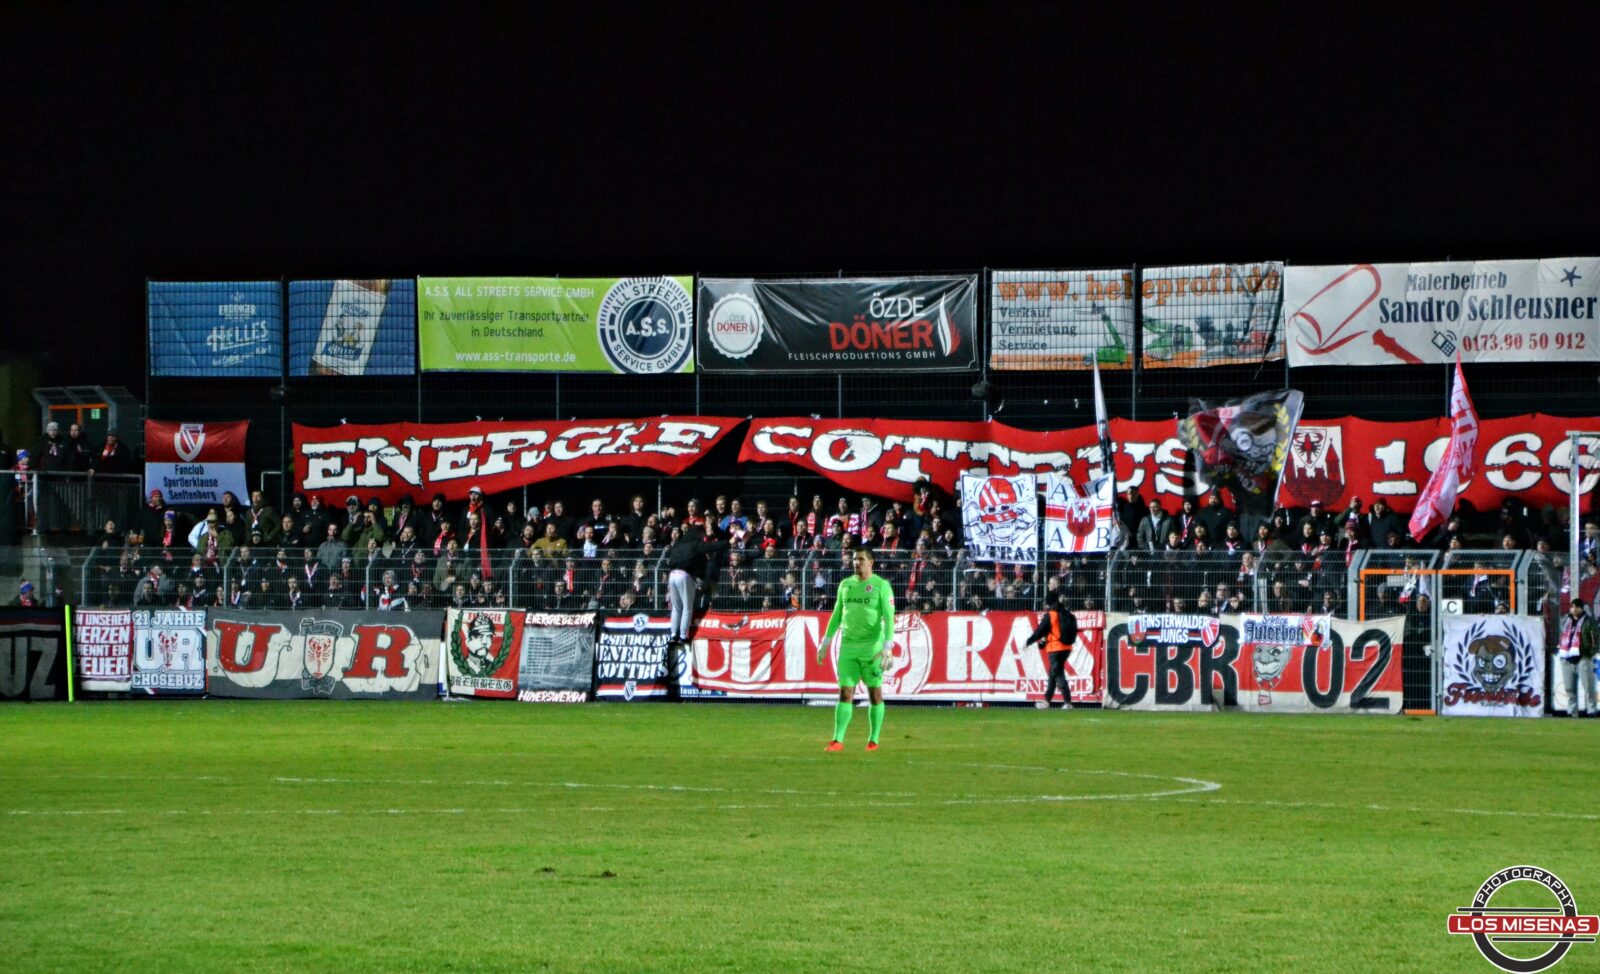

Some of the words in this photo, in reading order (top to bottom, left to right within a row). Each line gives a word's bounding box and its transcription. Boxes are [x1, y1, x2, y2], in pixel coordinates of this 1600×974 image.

[1407, 271, 1508, 292] Malerbetrieb
[425, 286, 450, 297] A.S.S.
[455, 286, 472, 297] ALL
[477, 286, 520, 297] STREETS
[524, 286, 562, 297] SERVICE
[566, 287, 594, 298] GMBH
[612, 293, 631, 314] ALL
[632, 284, 682, 311] STREETS
[218, 304, 256, 316] ERDINGER
[870, 292, 926, 318] ÖZDE
[999, 306, 1052, 318] Verkauf
[1380, 298, 1460, 324] Sandro
[1468, 292, 1598, 322] Schleusner
[424, 310, 434, 321] Ihr
[439, 310, 504, 323] zuverlässiger
[508, 310, 590, 323] Transportpartner
[471, 326, 480, 337] in
[484, 326, 545, 338] Deutschland.
[626, 316, 670, 337] A.S.S.
[829, 314, 934, 350] DÖNER
[999, 323, 1078, 336] Vermietung
[206, 320, 269, 352] HELLES
[1462, 333, 1522, 352] 0173.90
[1529, 334, 1549, 350] 50
[1555, 332, 1586, 350] 912
[999, 340, 1047, 351] Service
[455, 350, 576, 364] www.ass-transporte.de
[614, 344, 653, 372] SERVICE
[656, 343, 683, 370] GMBH
[788, 352, 901, 361] FLEISCHPRODUKTIONS
[905, 350, 936, 360] GMBH
[302, 421, 721, 490] ENERGIE
[174, 464, 204, 476] Fanclub
[168, 490, 217, 502] Senftenberg
[1446, 600, 1458, 614] C
[85, 613, 130, 626] UNSEREN
[132, 611, 150, 626] 21
[153, 610, 205, 626] JAHRE
[468, 612, 502, 622] EGIE
[525, 612, 596, 625] ENERGIEBEZIRK
[750, 618, 785, 629] FRONT
[1142, 615, 1209, 629] FINSTERWALDER
[1158, 628, 1190, 644] JUNGS
[80, 644, 111, 656] ENNT
[112, 644, 129, 656] EIN
[214, 621, 281, 673] U
[343, 624, 412, 678] R
[80, 656, 128, 676] EUER
[598, 662, 668, 680] COTTBUS
[1302, 628, 1392, 709] 02
[132, 673, 204, 688] CHOSEBUZ
[450, 676, 512, 690] PREMBERG
[1015, 679, 1092, 693] ENEGIE
[518, 690, 586, 702] HOYERSWERDA
